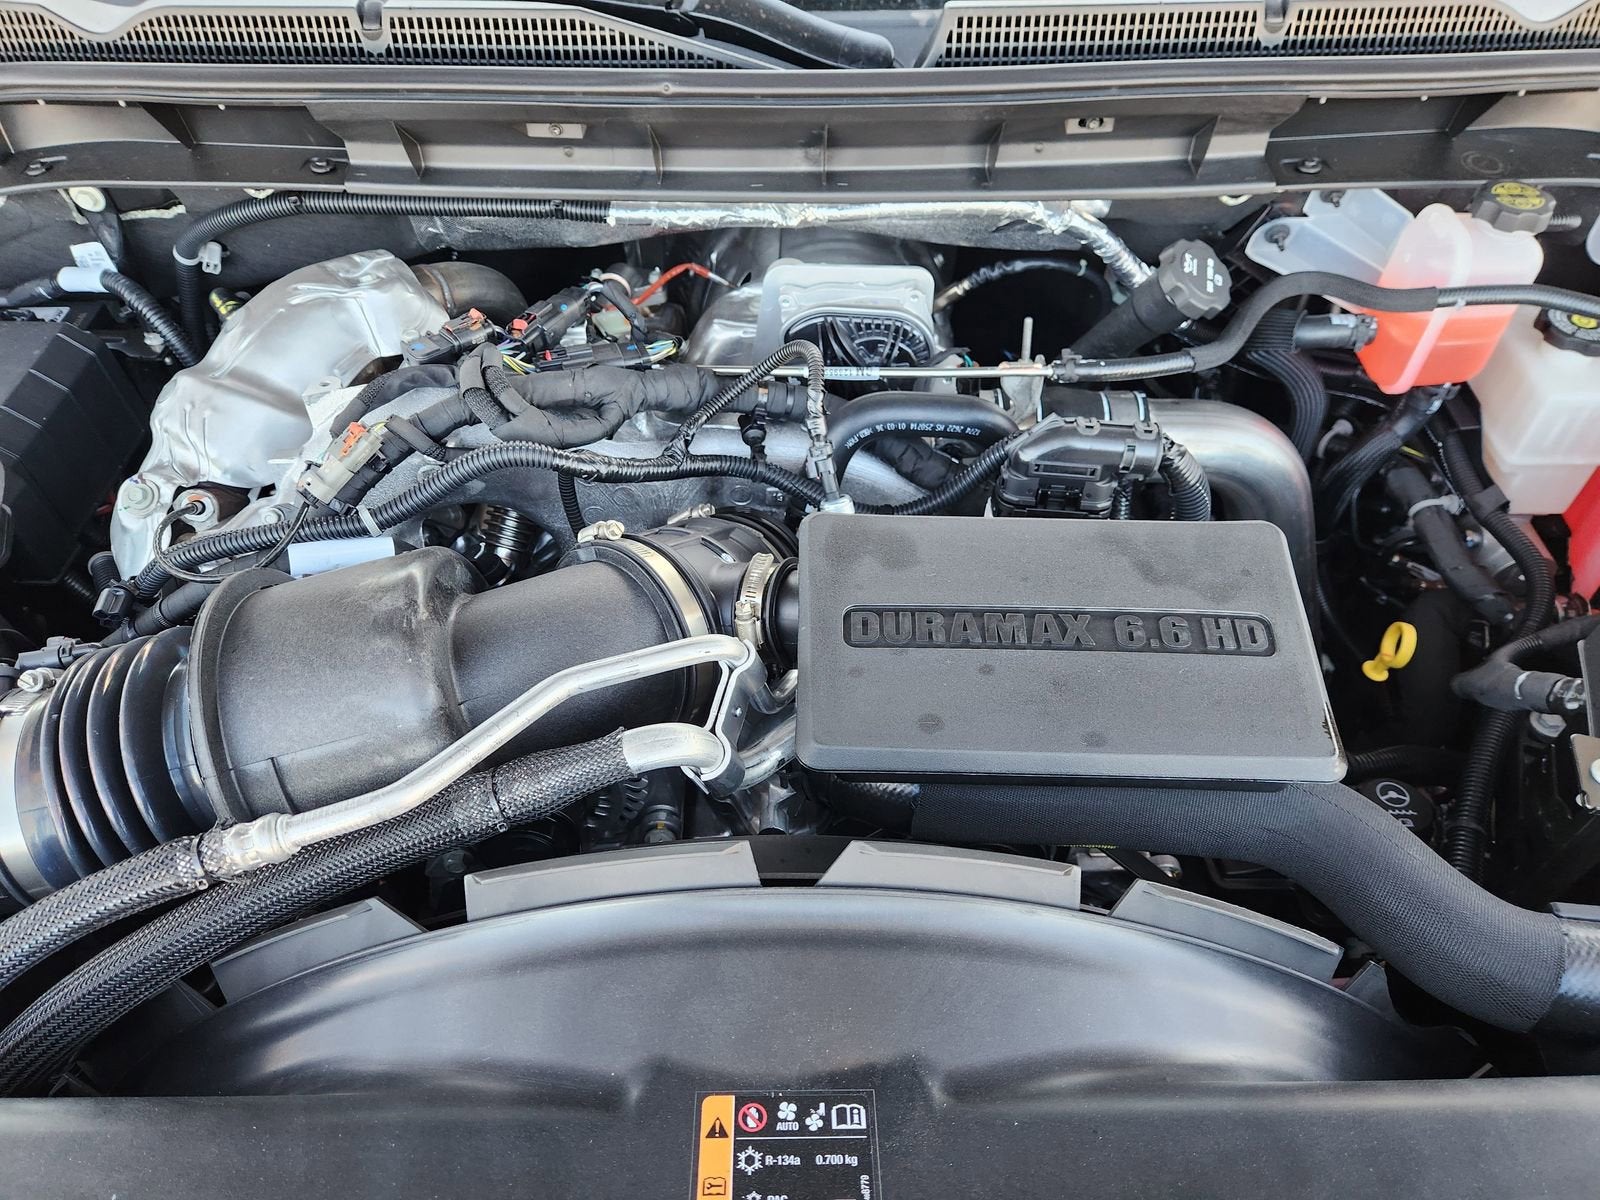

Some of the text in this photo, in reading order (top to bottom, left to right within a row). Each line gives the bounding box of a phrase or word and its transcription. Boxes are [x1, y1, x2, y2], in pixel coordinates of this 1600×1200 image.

[850, 611, 1270, 652] DURAMAX 6.6 HD
[775, 1121, 800, 1132] AUTO
[765, 1154, 858, 1167] R-134a 0.700 kg
